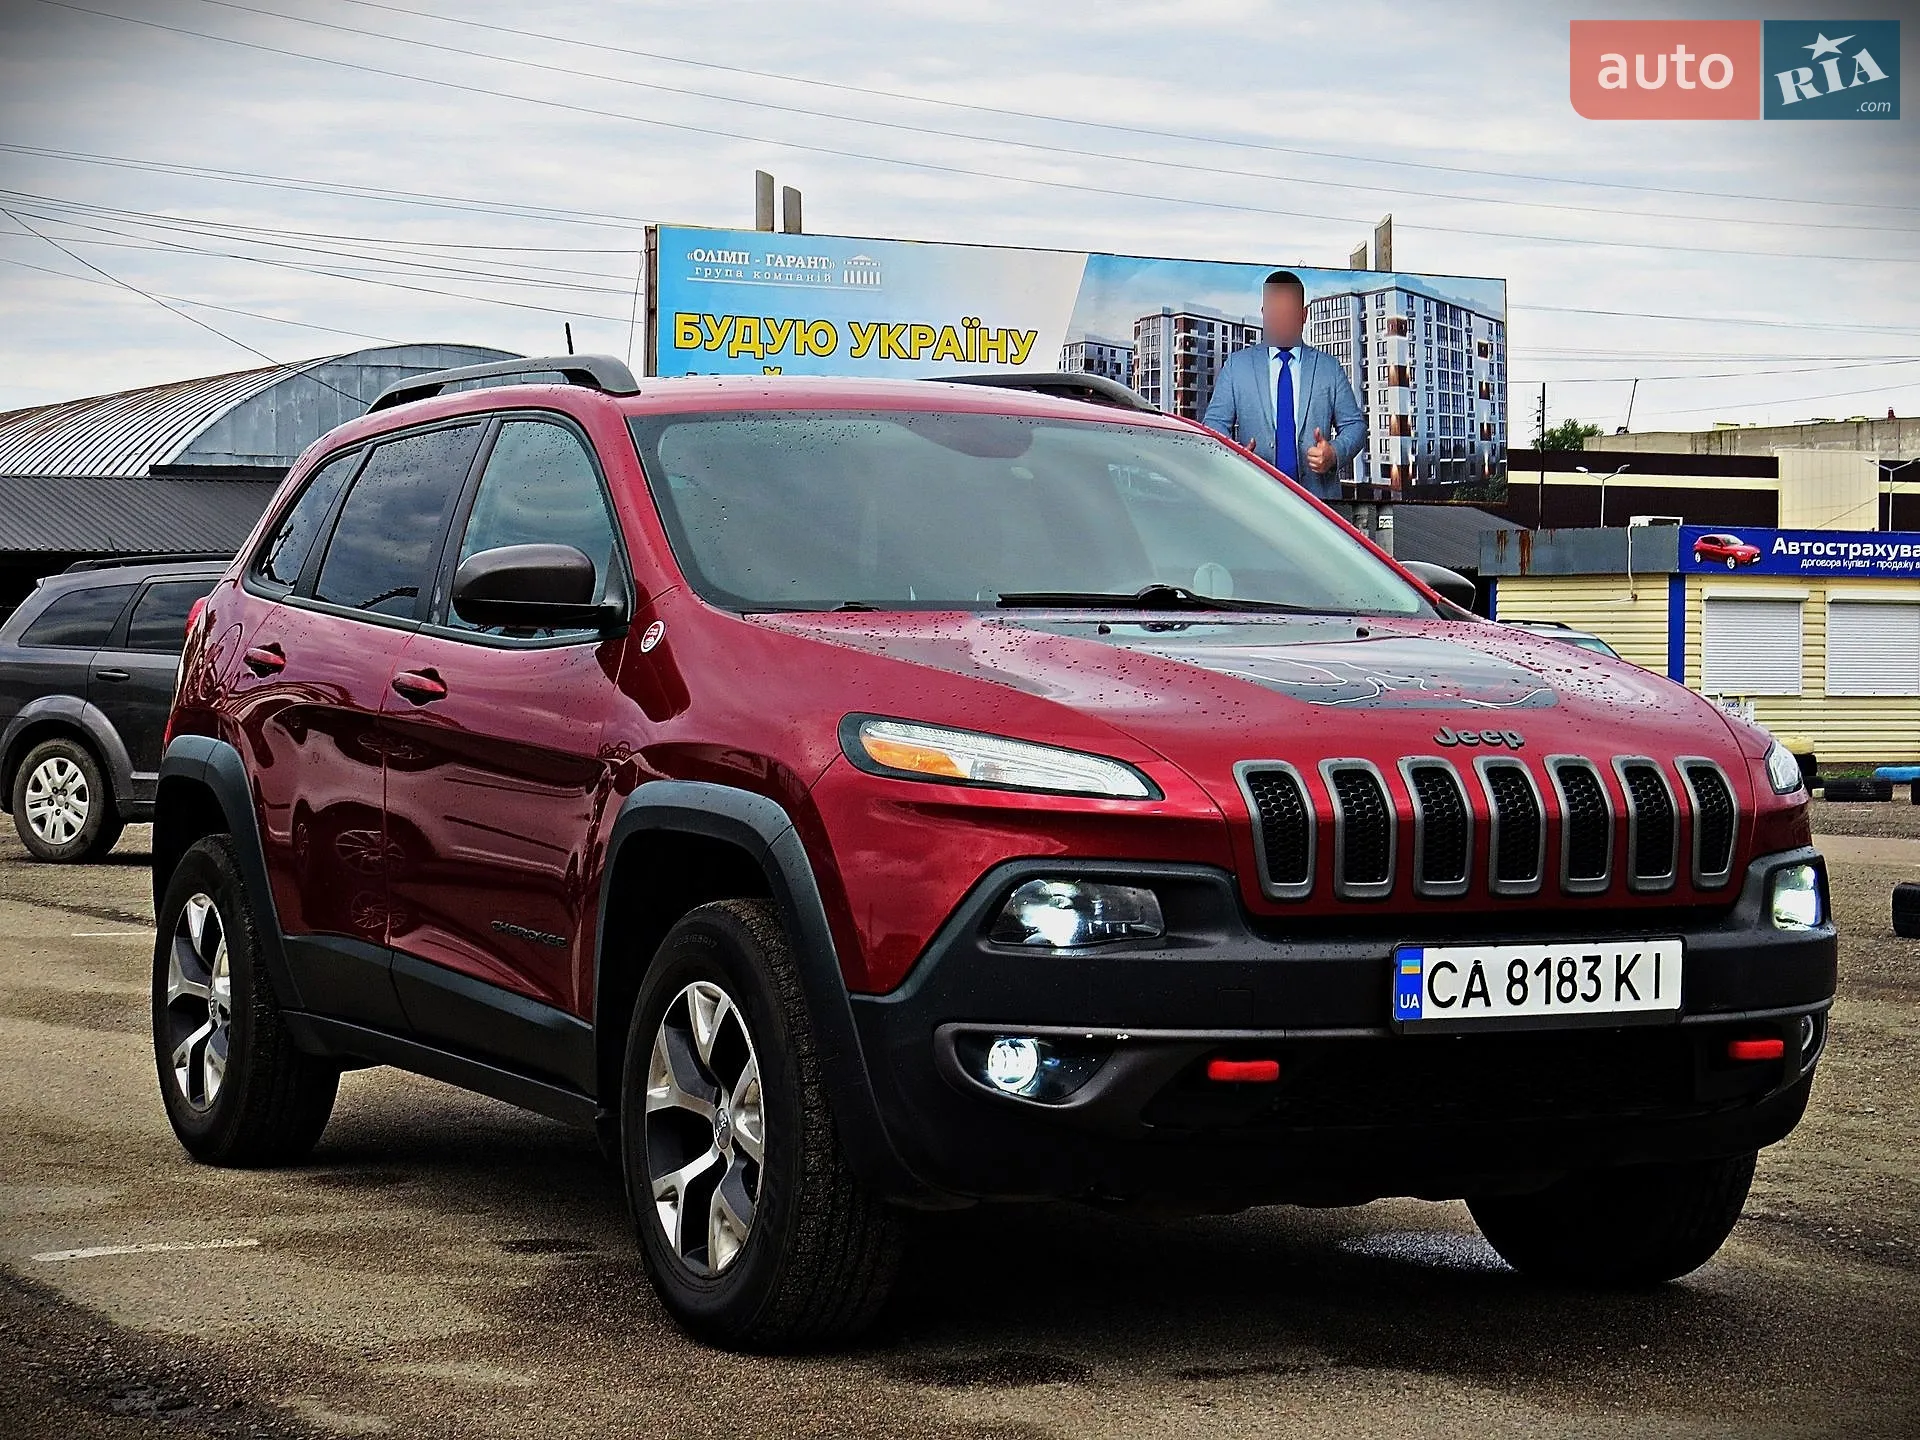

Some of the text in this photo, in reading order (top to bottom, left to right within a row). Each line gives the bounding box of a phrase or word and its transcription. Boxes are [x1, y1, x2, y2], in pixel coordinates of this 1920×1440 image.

[687, 248, 750, 265] «ОЛІМП
[765, 253, 835, 270] ГАРАНТ»
[695, 266, 832, 283] група компаній
[674, 312, 1038, 364] БУДУЮ УКРАЇНУ
[1772, 537, 1920, 561] Автострахува
[1800, 558, 1842, 570] договора
[1876, 560, 1914, 571] продажу
[1432, 725, 1525, 751] Jeep
[490, 919, 568, 948] CHEROKEE
[1427, 959, 1492, 1009] CA
[1506, 954, 1603, 1006] 8183
[1400, 993, 1421, 1010] UA
